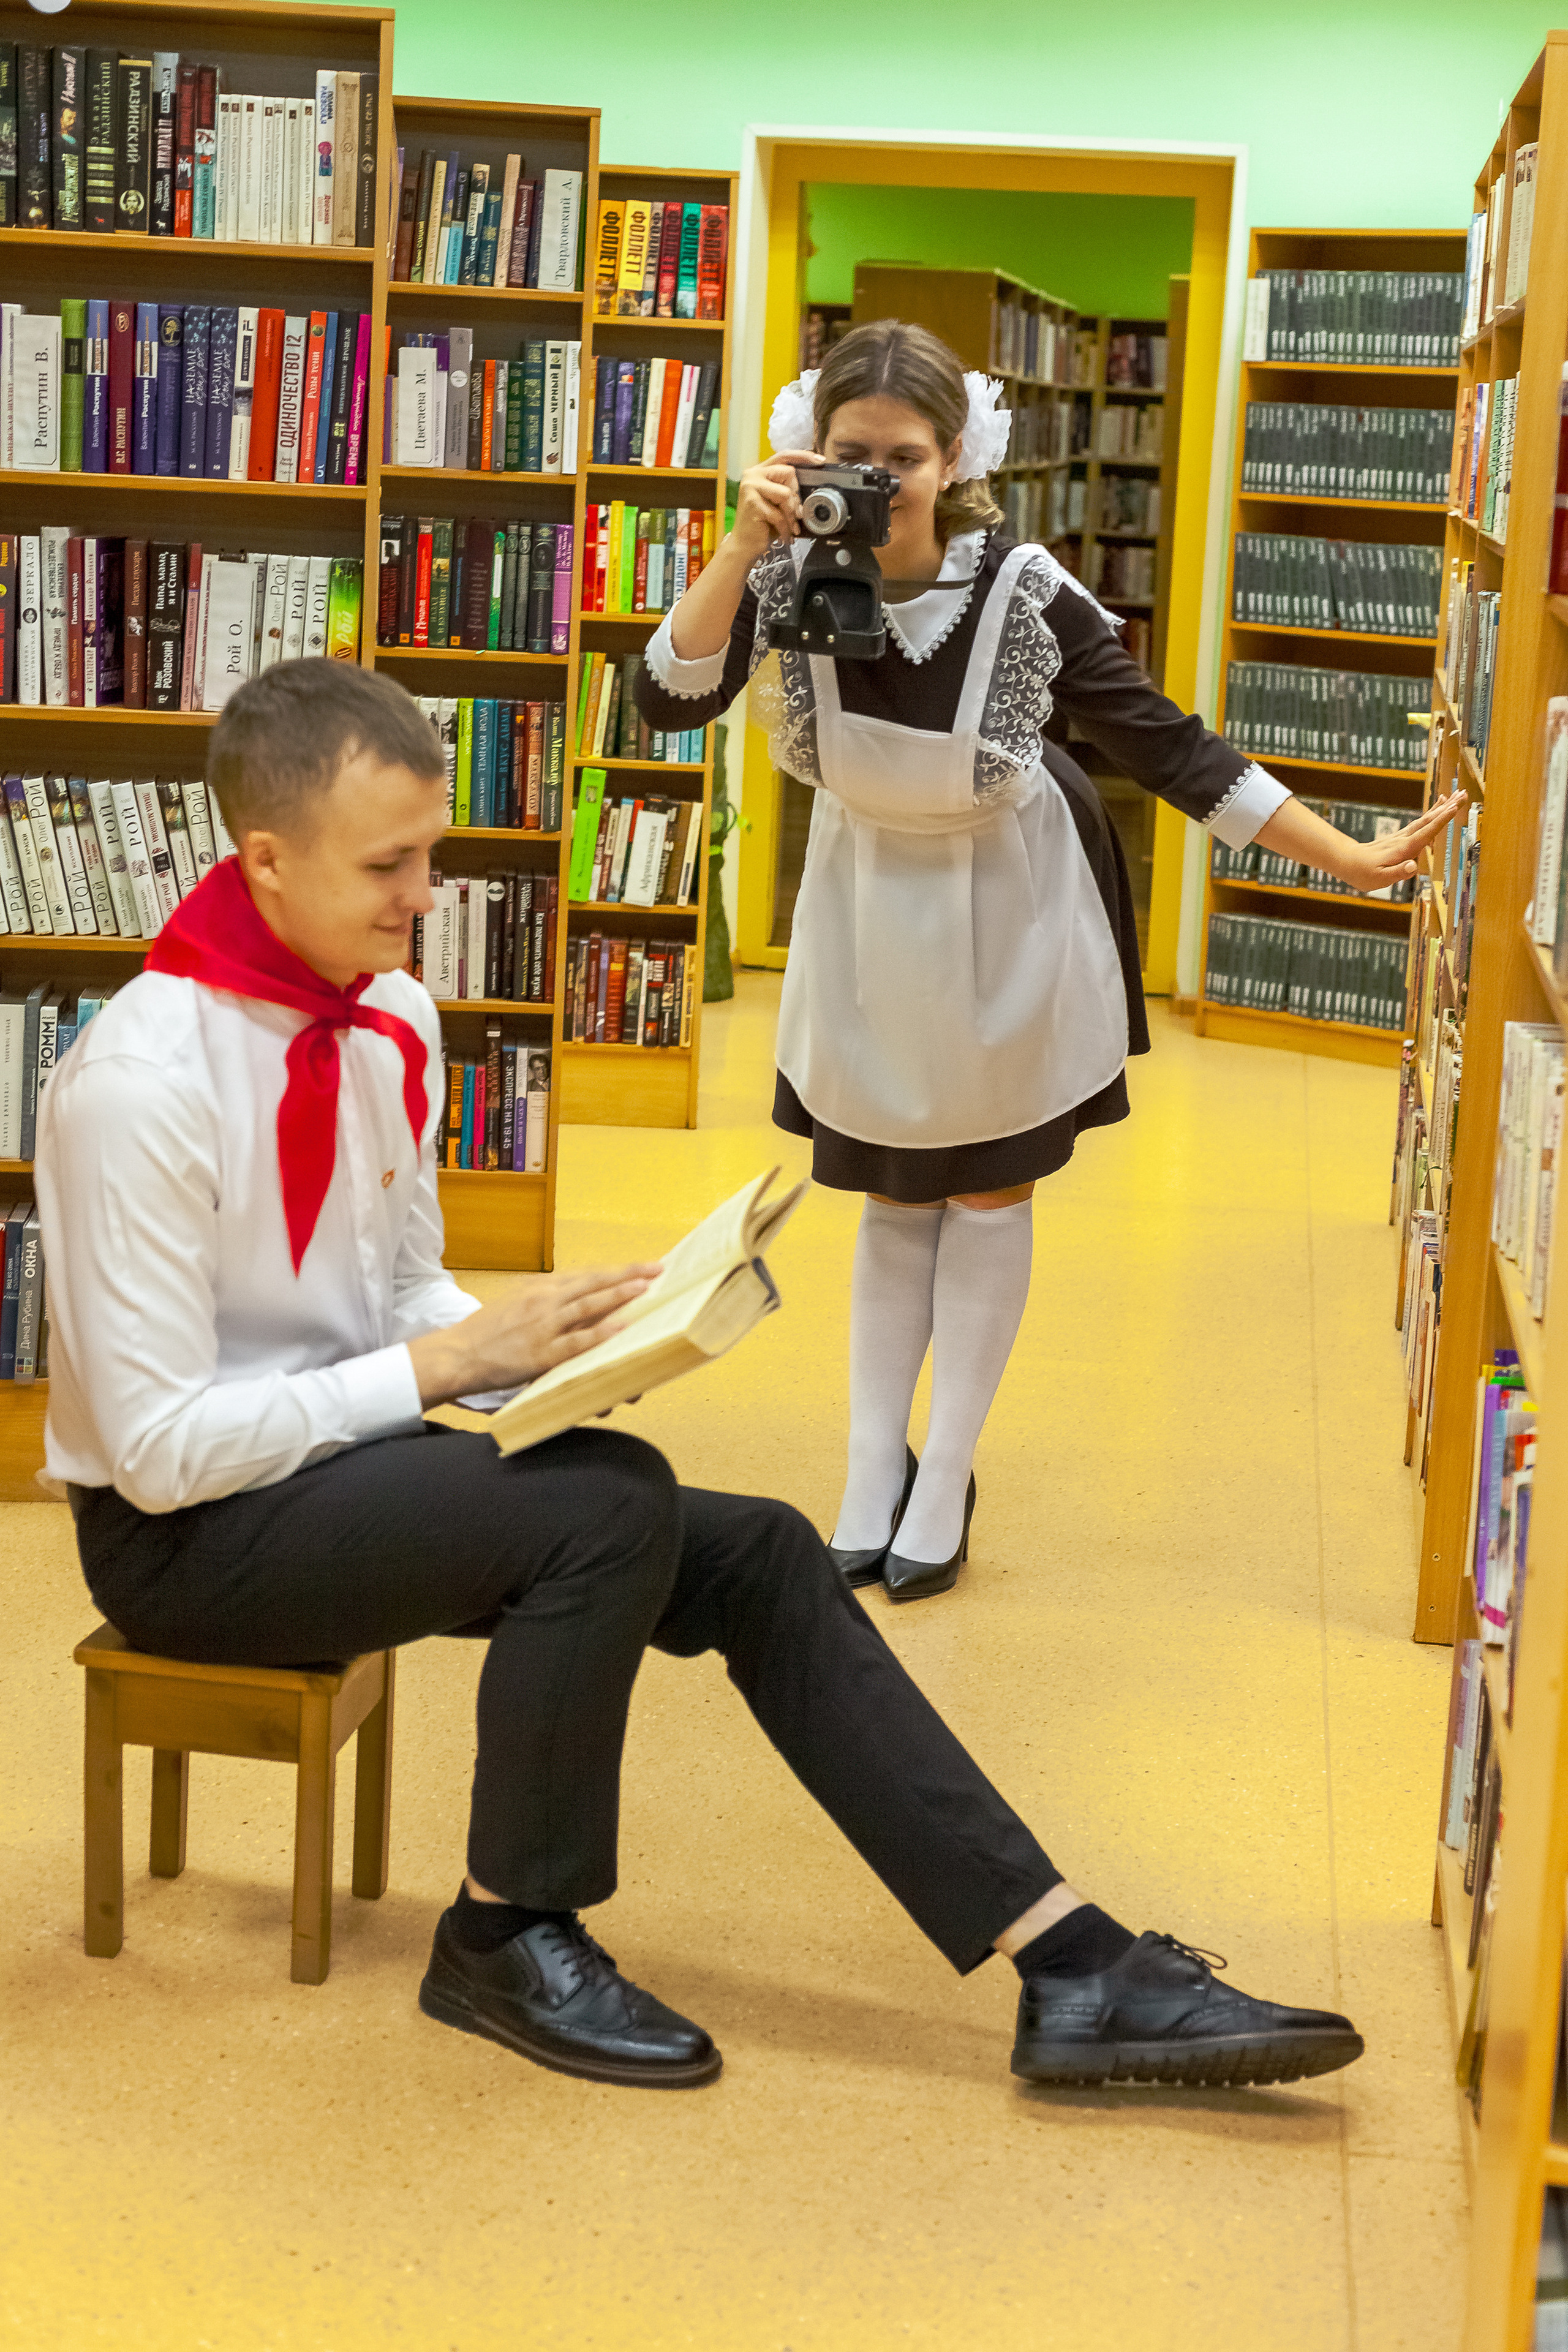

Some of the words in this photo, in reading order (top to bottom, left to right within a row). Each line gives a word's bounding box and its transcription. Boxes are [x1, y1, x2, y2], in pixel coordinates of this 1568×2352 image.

[100, 62, 111, 145] РАДЗИНСКИЙ
[127, 71, 141, 163] РАДЗИНСКИЙ
[562, 178, 573, 190] А.
[554, 198, 571, 280] Твардовский
[598, 211, 620, 278] ФОЛЛЕТТ
[625, 211, 646, 276] ФОЛЛЕТТ
[680, 214, 699, 276] ФОЛЛЕТТ
[35, 347, 48, 363] В.
[285, 335, 301, 347] 12
[92, 377, 102, 415] Распутин
[307, 376, 318, 399] Розы
[415, 369, 427, 385] М.
[469, 372, 482, 420] Цветаева
[550, 372, 559, 413] ЧЕРНЫЙ
[34, 372, 51, 448] Распутин
[141, 380, 150, 418] Распутин
[280, 353, 300, 448] ОДИНОЧЕСТВО
[116, 407, 126, 448] РАСПУТИН
[414, 392, 427, 449] Цветаева
[348, 434, 360, 467] ВРЕМЯ
[48, 540, 56, 598] РОЖДЕСТВЕНСКАЯ
[158, 551, 168, 581] мама,
[168, 554, 178, 588] Сталин
[270, 564, 287, 595] Рой
[155, 582, 165, 609] Папа,
[291, 581, 306, 619] РОЙ
[312, 584, 327, 623] РОЙ
[228, 620, 243, 636] О.
[162, 641, 174, 688] РОЗОВСКИЙ
[227, 645, 241, 673] Рой
[546, 737, 562, 786] Маккалоу
[23, 784, 47, 819] Рой
[186, 790, 209, 825] Рой
[22, 832, 32, 855] КРАСКИ
[38, 820, 48, 843] Олег
[98, 804, 119, 845] РОЙ
[121, 807, 141, 846] РОЙ
[198, 825, 209, 848] Олег
[439, 907, 452, 984] Австрийская
[40, 1022, 55, 1068] РОММ
[504, 1066, 514, 1109] ЭКСПРЕСС
[504, 1112, 511, 1123] НА
[503, 1126, 511, 1149] 19:45
[24, 1239, 38, 1278] ОКНА
[21, 1290, 34, 1323] Рубина
[20, 1325, 31, 1350] Дина
